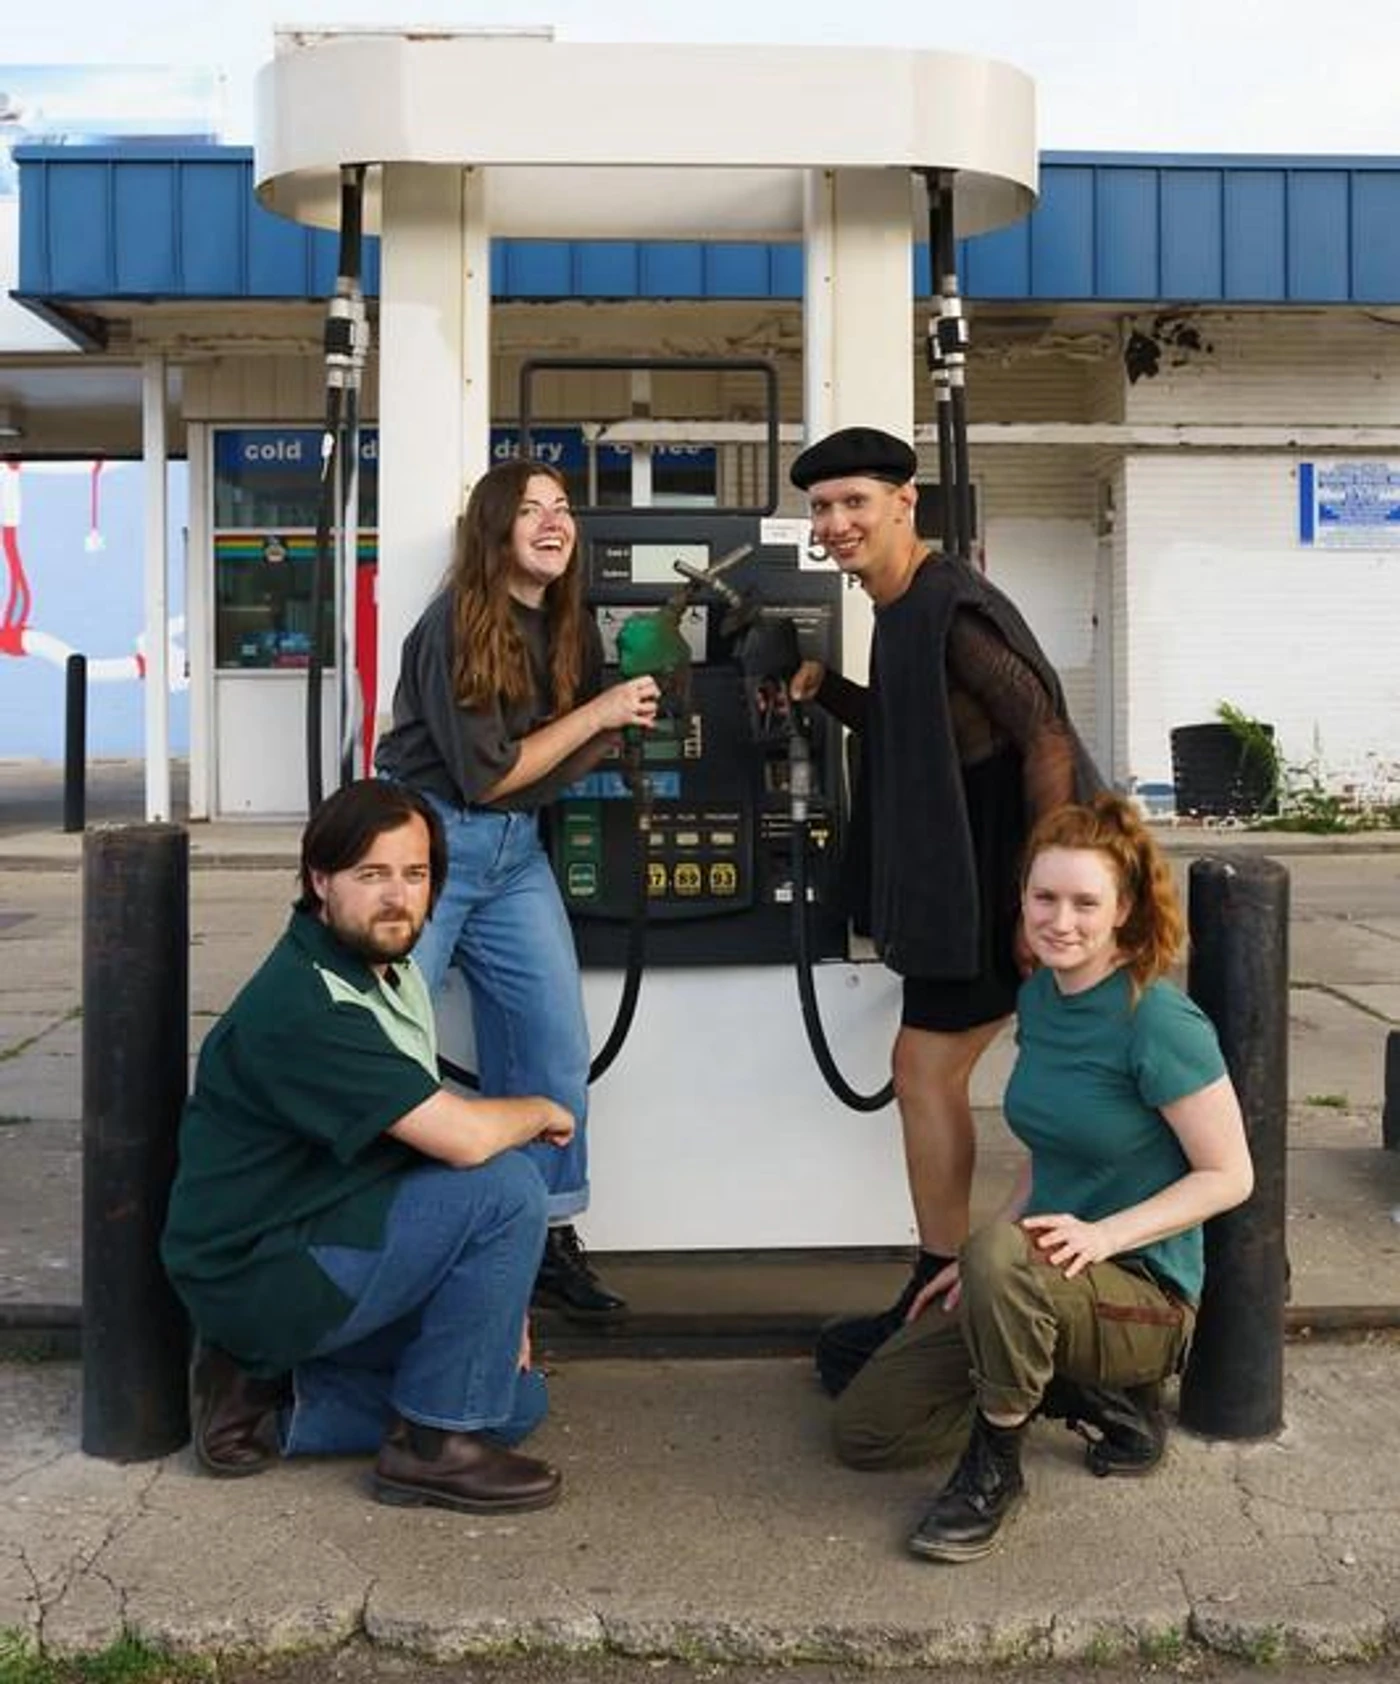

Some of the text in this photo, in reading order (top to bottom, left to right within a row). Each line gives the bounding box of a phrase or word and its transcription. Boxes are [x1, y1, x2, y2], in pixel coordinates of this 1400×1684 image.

[244, 438, 302, 460] cold
[678, 871, 699, 886] 89
[713, 871, 733, 886] 93
